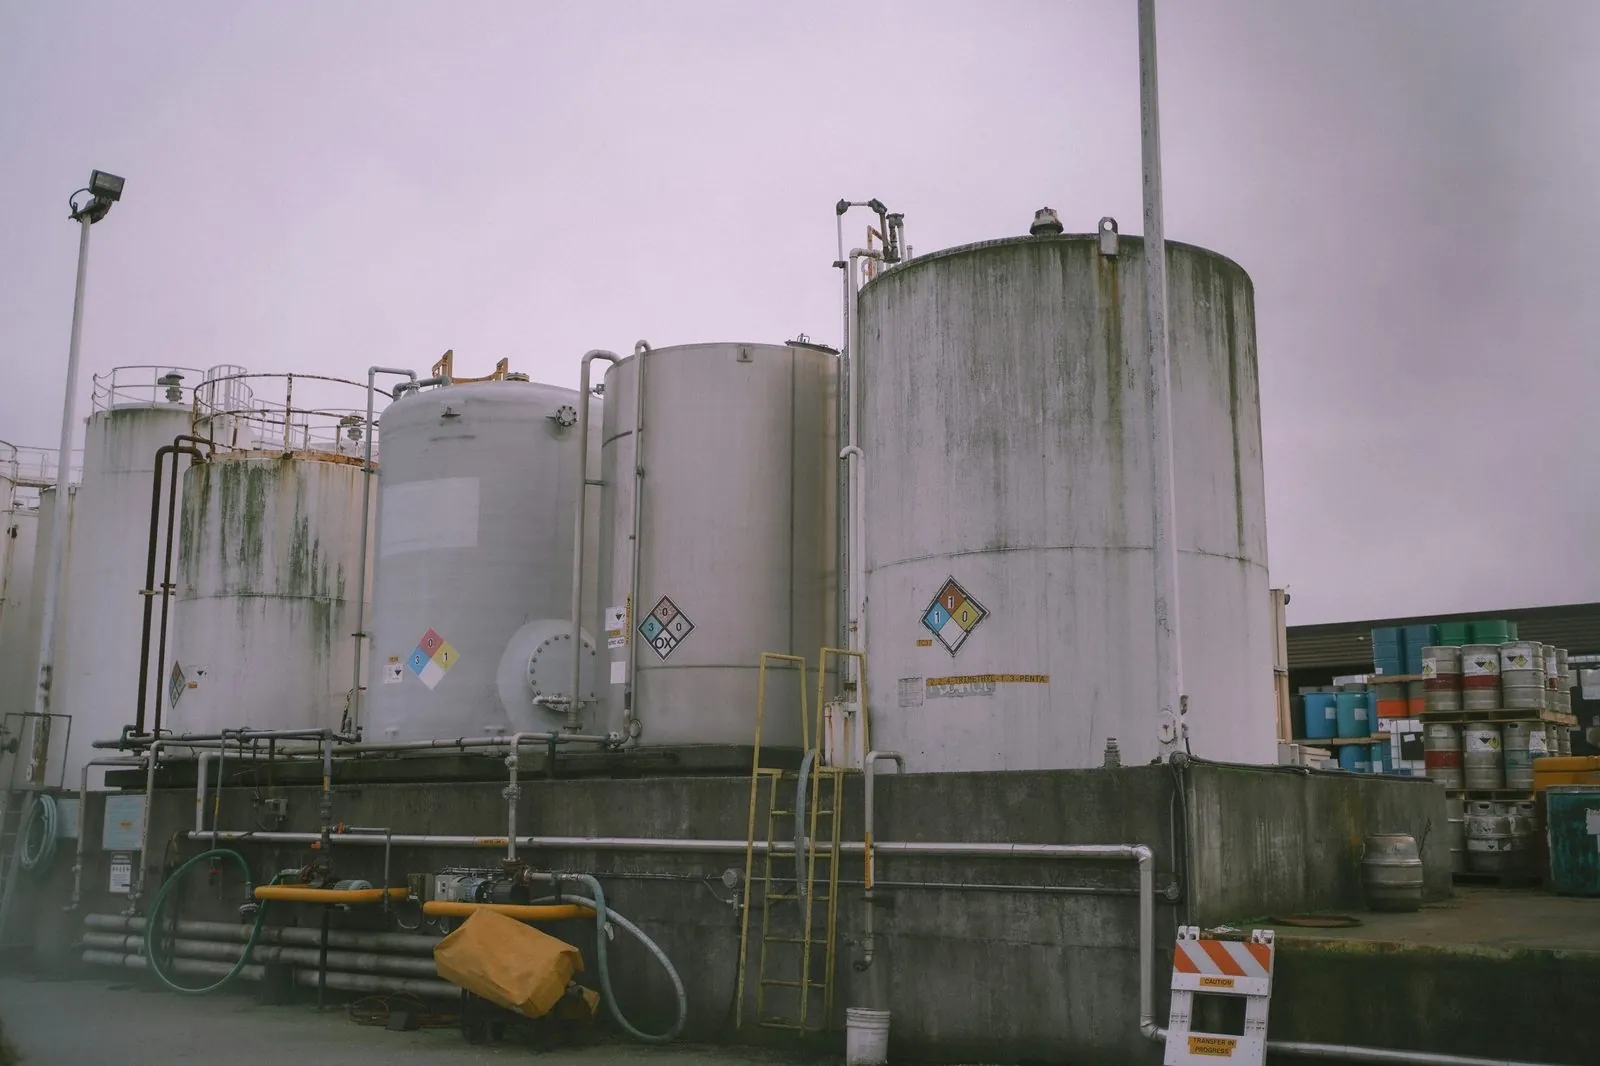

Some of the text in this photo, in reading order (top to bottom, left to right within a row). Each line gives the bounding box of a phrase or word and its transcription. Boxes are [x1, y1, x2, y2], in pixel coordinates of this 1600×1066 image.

[948, 595, 955, 609] 1
[662, 607, 668, 616] 0
[934, 610, 968, 624] 1 0
[648, 622, 682, 631] 3 0
[428, 639, 433, 648] 0
[654, 637, 672, 649] OX
[415, 652, 448, 665] 3 1
[1193, 1037, 1226, 1045] TRANSFER
[1194, 1046, 1229, 1054] PROGRESS
